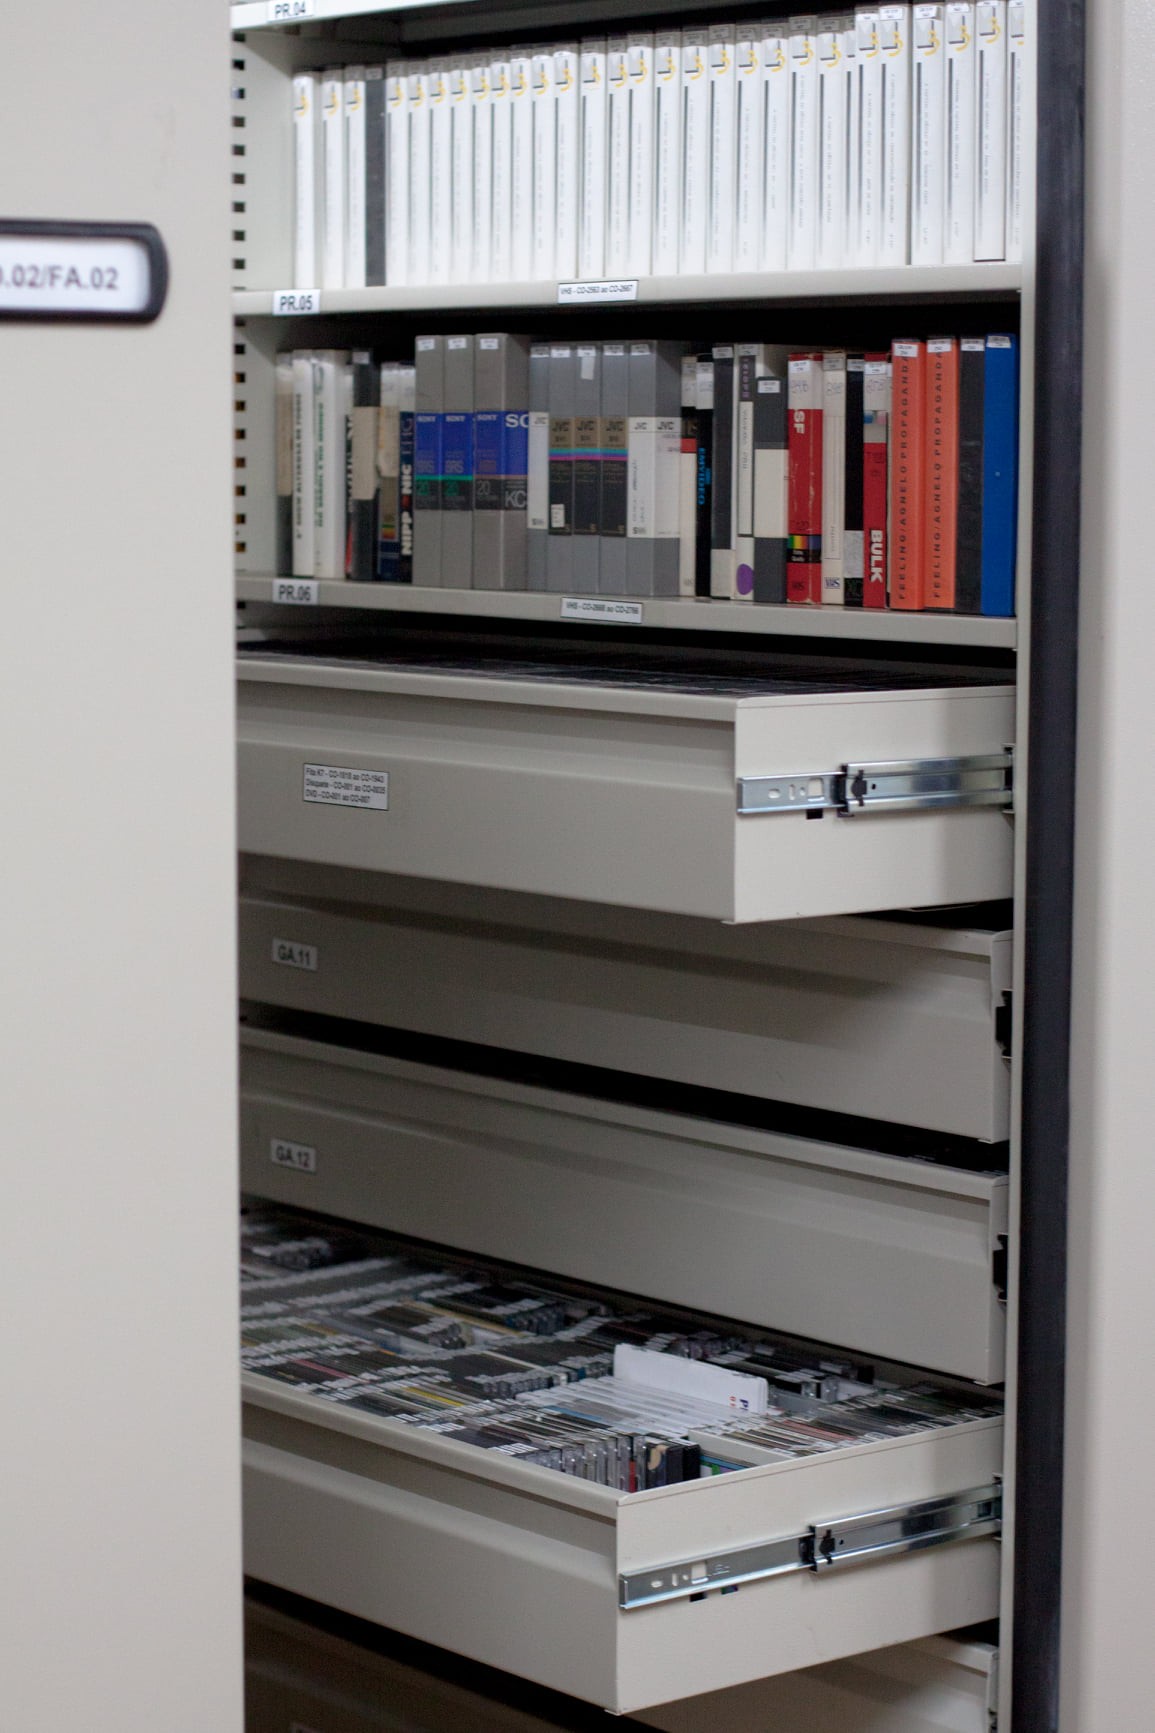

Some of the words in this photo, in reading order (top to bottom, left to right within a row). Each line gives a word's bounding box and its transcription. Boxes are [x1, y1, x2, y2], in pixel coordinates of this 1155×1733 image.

[0, 264, 119, 290] .02/FA.02
[280, 295, 313, 311] PR.05
[870, 529, 883, 584] BULK
[278, 585, 311, 602] PR.06
